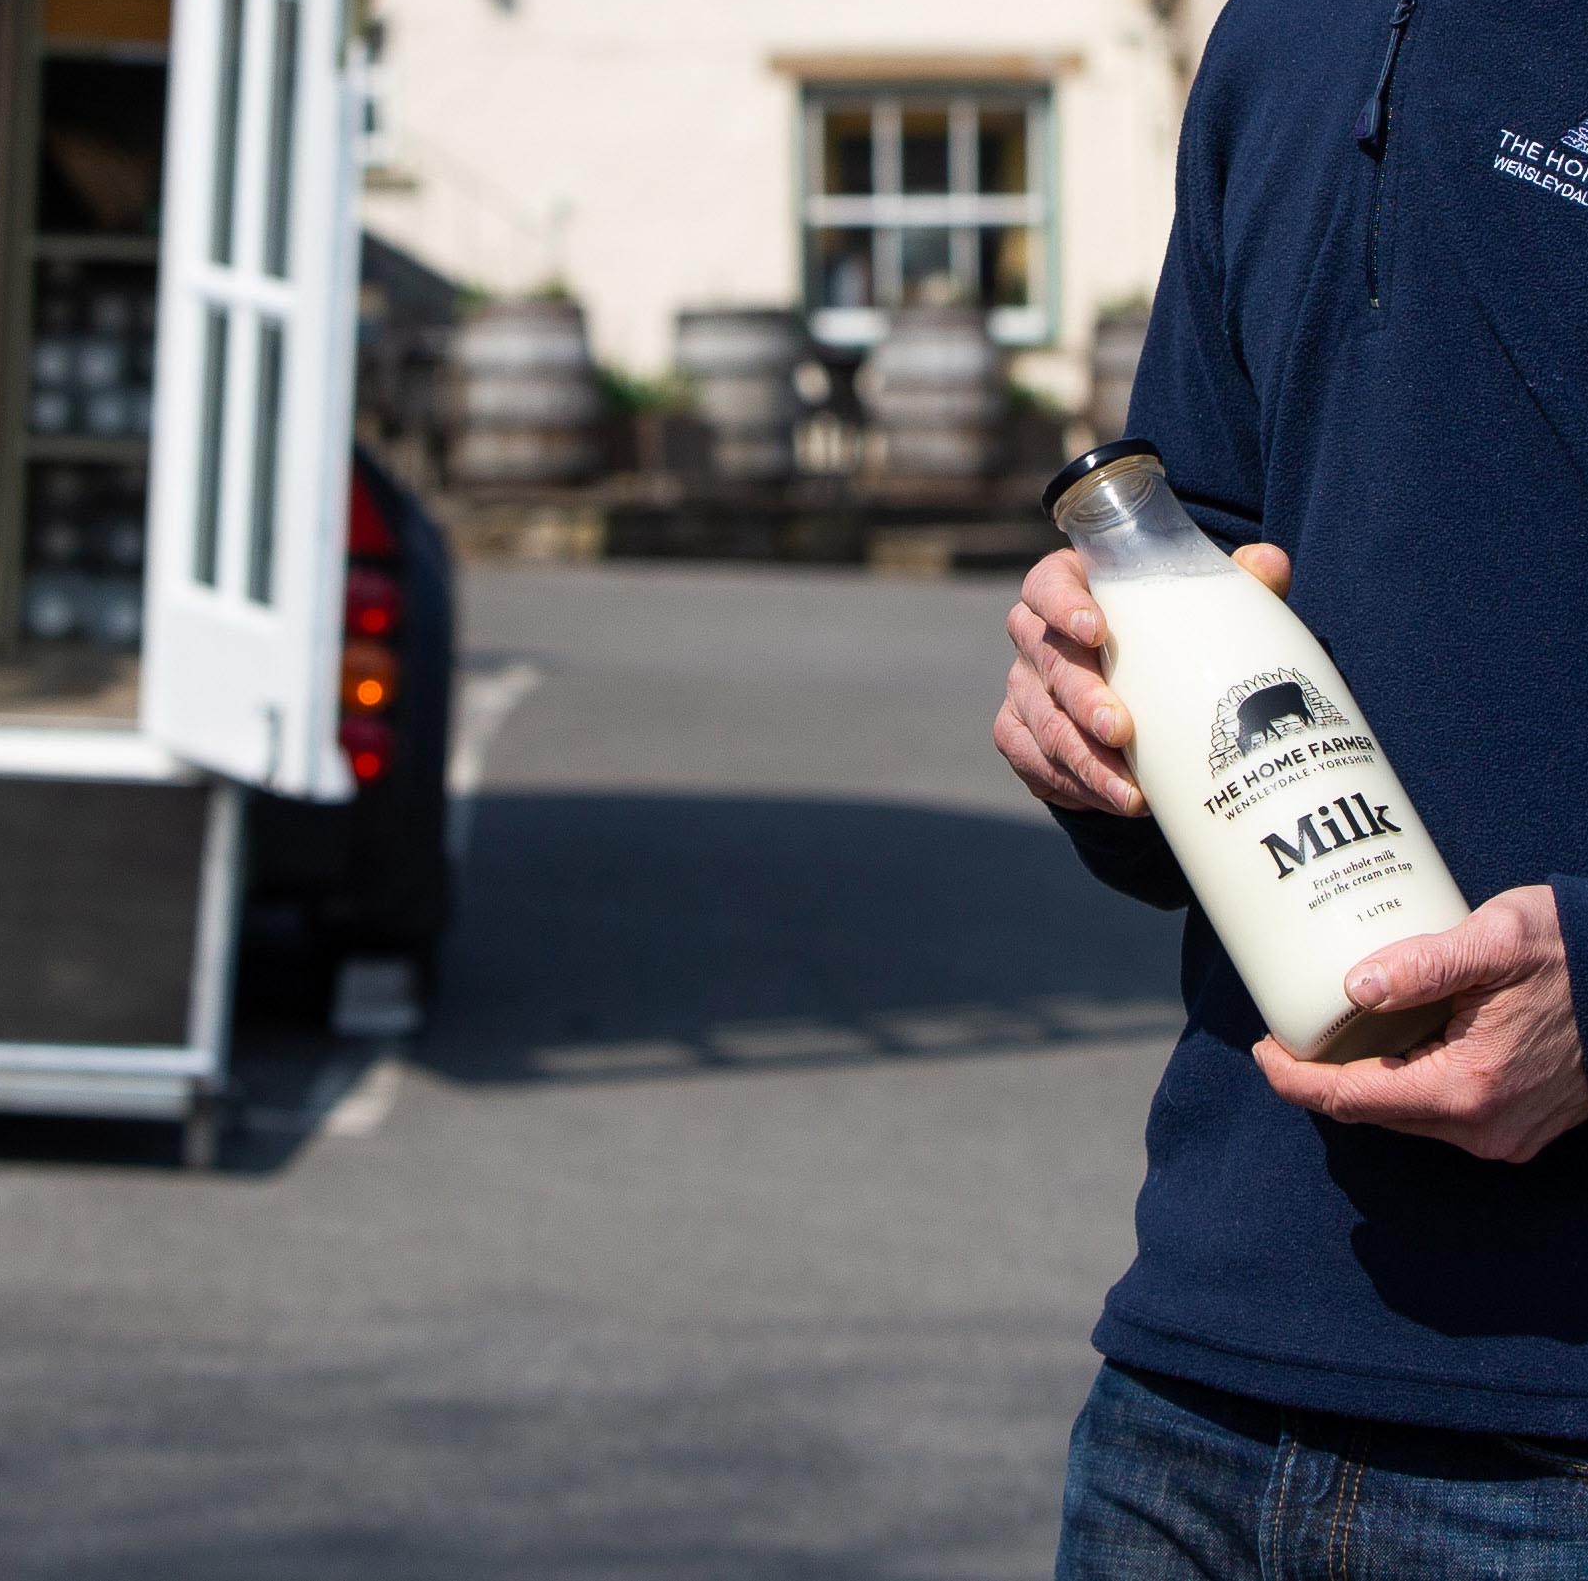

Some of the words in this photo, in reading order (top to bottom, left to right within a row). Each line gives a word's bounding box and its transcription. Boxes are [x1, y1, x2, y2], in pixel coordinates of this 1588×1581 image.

[1500, 129, 1544, 161] THE
[1204, 781, 1241, 815] THE
[1242, 748, 1307, 788] HOME
[1308, 735, 1375, 758] FARMER
[1225, 767, 1310, 820] WENSLEYDALE
[1318, 754, 1375, 771] YORKSHIRE
[1260, 792, 1402, 880] Milk
[1308, 890, 1332, 910] with
[1334, 880, 1350, 895] the
[1352, 869, 1383, 886] cream
[1384, 865, 1397, 875] on
[1397, 861, 1413, 873] top
[1312, 868, 1341, 890] Fresh
[1342, 856, 1372, 876] whole
[1374, 849, 1396, 864] milk
[1366, 898, 1402, 918] LITRE
